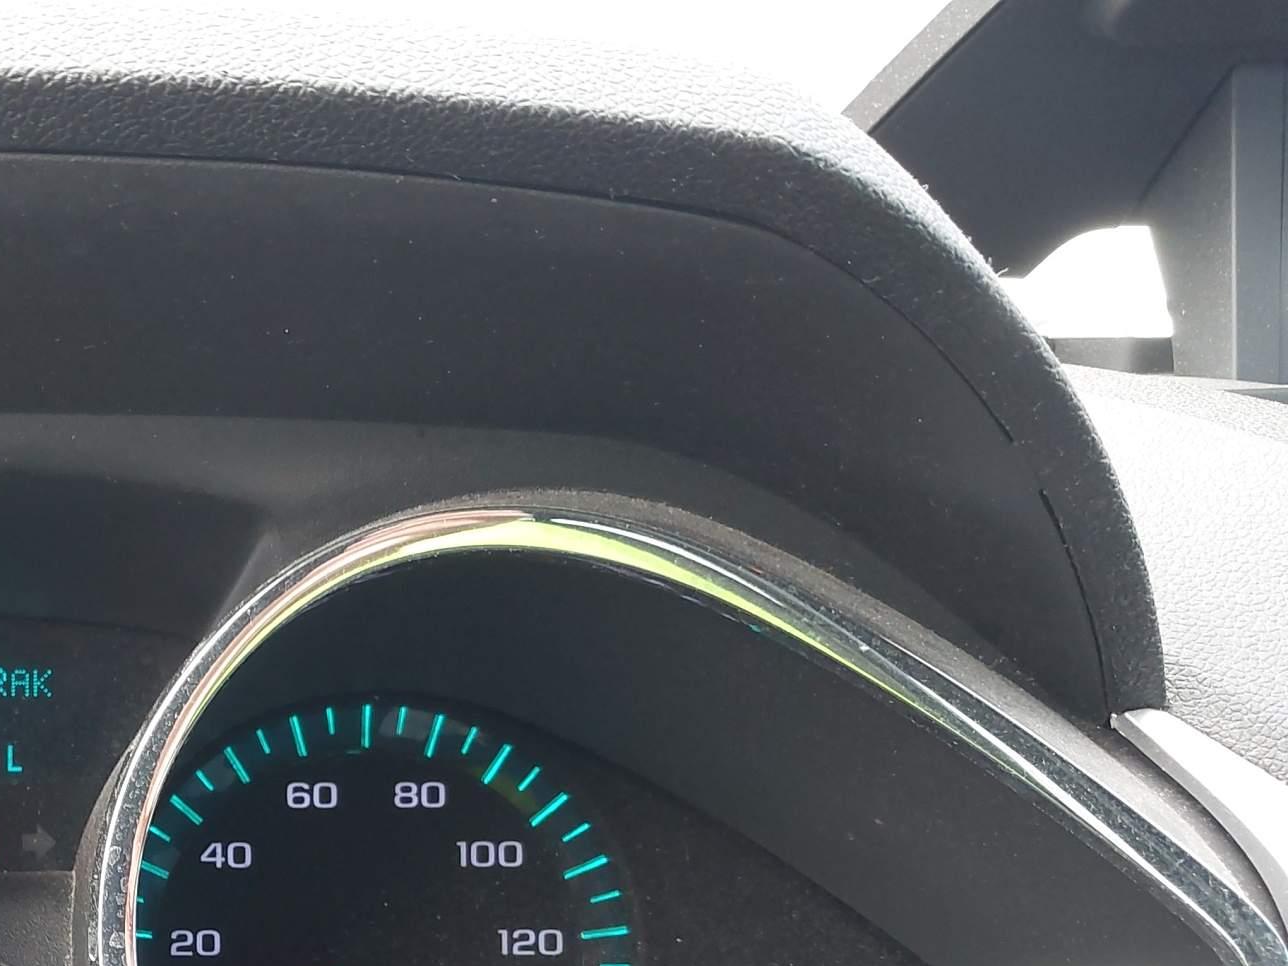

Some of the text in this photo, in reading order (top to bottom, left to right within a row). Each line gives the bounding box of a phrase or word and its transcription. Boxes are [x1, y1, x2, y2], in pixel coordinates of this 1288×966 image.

[8, 745, 23, 772] L
[286, 782, 338, 809] 60
[393, 782, 446, 809] 80
[200, 842, 252, 869] 40
[456, 841, 524, 868] 100
[170, 930, 221, 957] 20
[497, 929, 563, 956] 120
